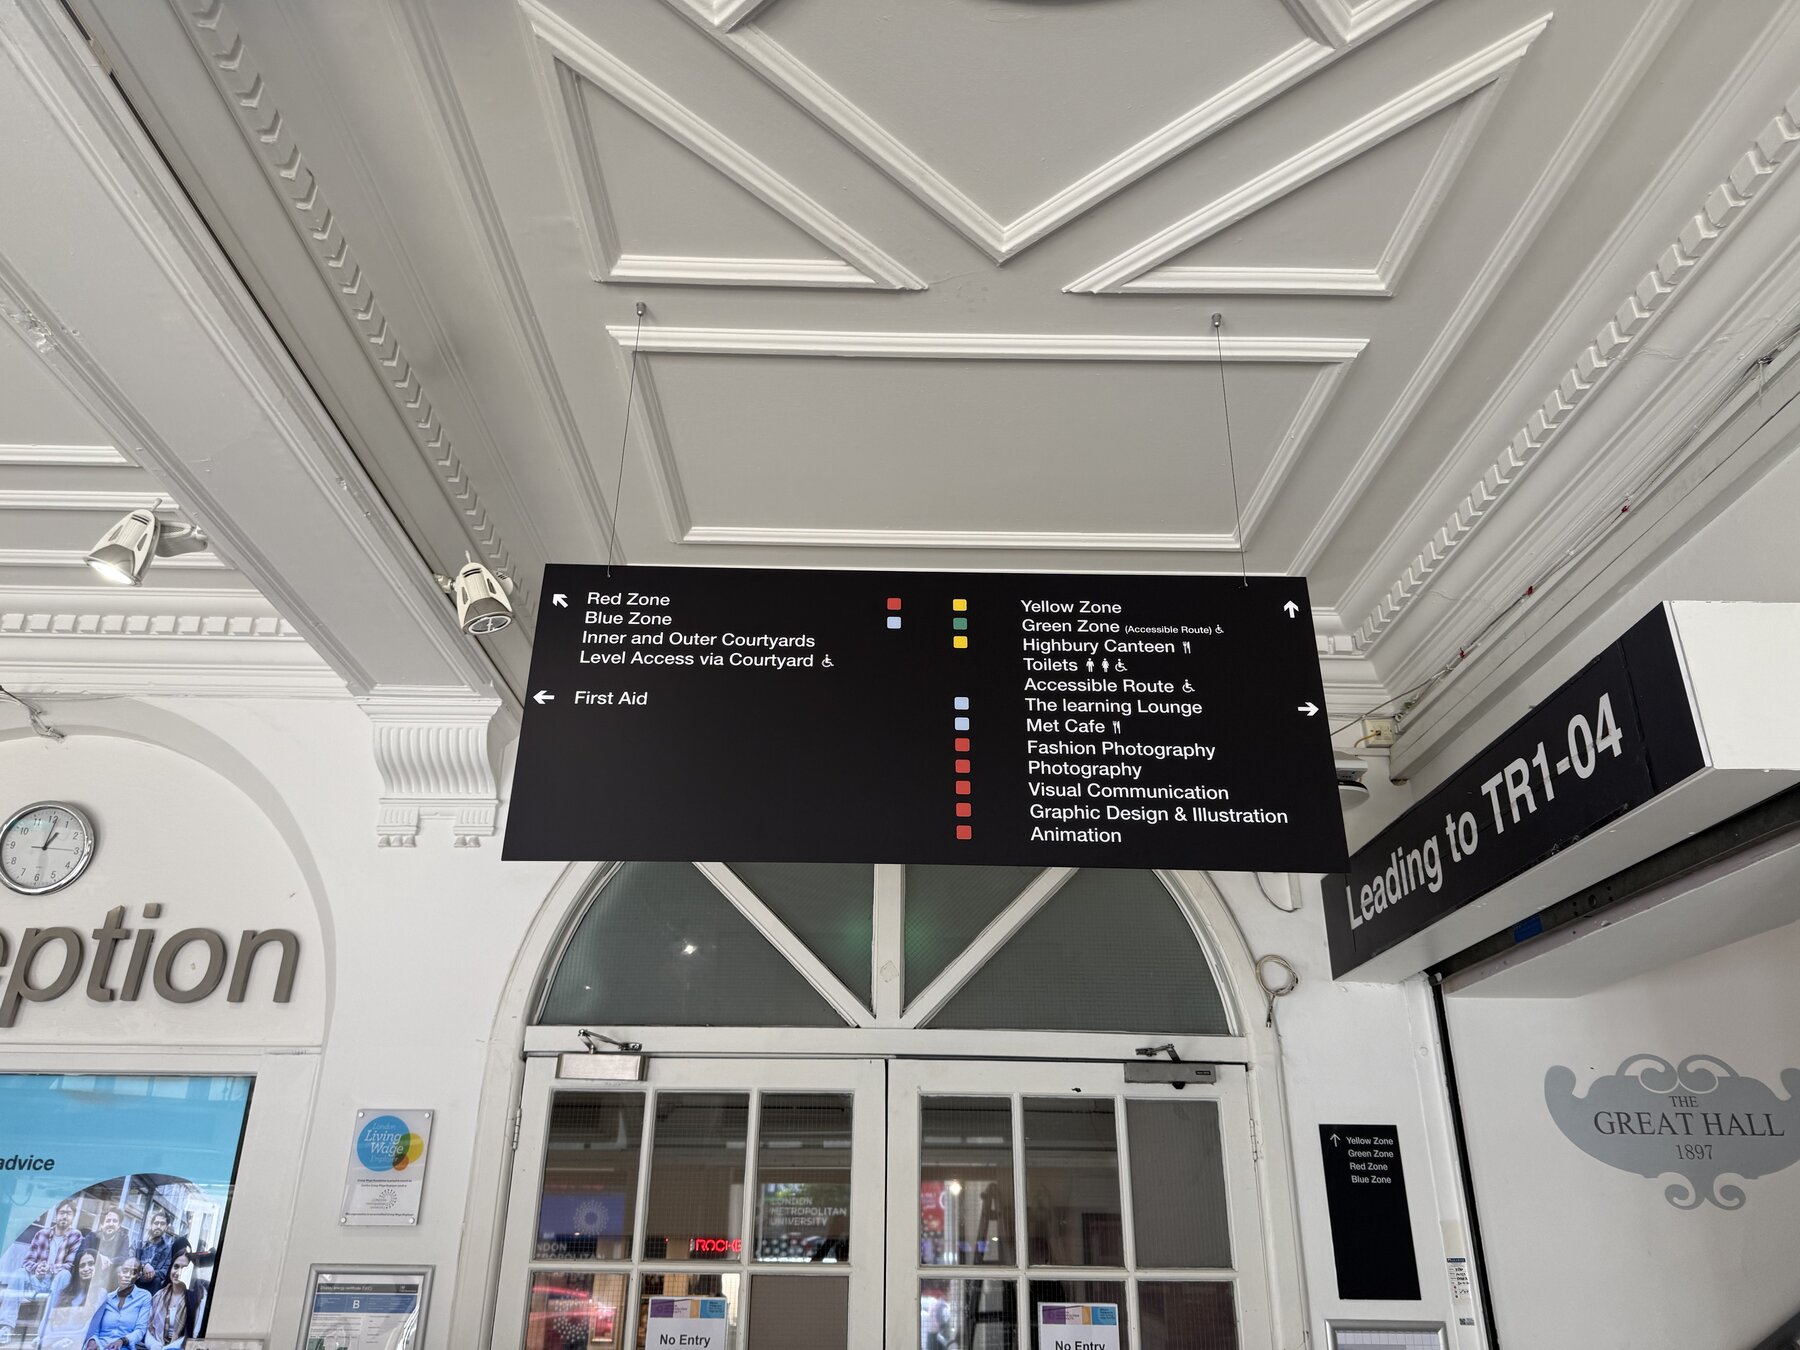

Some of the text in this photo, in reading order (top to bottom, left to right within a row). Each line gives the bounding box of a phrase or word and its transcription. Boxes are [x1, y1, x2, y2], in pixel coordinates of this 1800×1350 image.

[587, 591, 671, 607] Red Zone
[1020, 599, 1122, 614] Yellow Zone
[585, 610, 673, 626] Blue Zone
[1022, 618, 1213, 636] Green Zone (Accessible Route)
[582, 630, 816, 650] Inner and Outer Courtyards
[1023, 638, 1175, 655] Highbury Canteen
[579, 650, 814, 670] Level Access via Courtyard
[1022, 657, 1078, 672] Toilets
[1024, 677, 1175, 693] Accessible Route
[574, 690, 649, 706] First Aid
[1024, 697, 1203, 718] The learning Lounge
[1026, 718, 1106, 734] Met Cafe
[1027, 739, 1216, 761] Fashion Photography
[1028, 760, 1142, 780] Photography
[1028, 781, 1229, 800] Visual Communication
[1029, 803, 1289, 825] Graphic Design & Illustration
[1345, 691, 1624, 930] Leading to TR1-04
[33, 818, 42, 826] 11
[20, 827, 29, 835] 10
[72, 831, 79, 840] 2
[1030, 826, 1122, 843] Animation
[9, 841, 16, 849] 9
[73, 846, 80, 855] 3
[10, 857, 17, 865] 8
[64, 861, 71, 869] 4
[21, 867, 26, 876] 7
[33, 873, 40, 882] 6
[50, 871, 57, 879] 5
[0, 902, 300, 1028] ption
[1668, 1095, 1700, 1108] THE
[1593, 1111, 1785, 1137] GREAT HALL
[364, 1129, 402, 1145] Living
[1345, 1136, 1394, 1145] Yellow Zone
[370, 1141, 404, 1157] Wage
[1347, 1149, 1394, 1158] Green Zone
[1676, 1144, 1713, 1160] 1897
[1349, 1162, 1388, 1171] Red Zone
[1351, 1175, 1392, 1184] Blue Zone
[771, 1196, 813, 1206] LONDON
[769, 1206, 847, 1216] METROPOLITAN
[769, 1216, 829, 1226] UNIVERSITY
[352, 1299, 361, 1309] B
[659, 1333, 711, 1348] No Entry
[1055, 1340, 1106, 1350] No Entry
